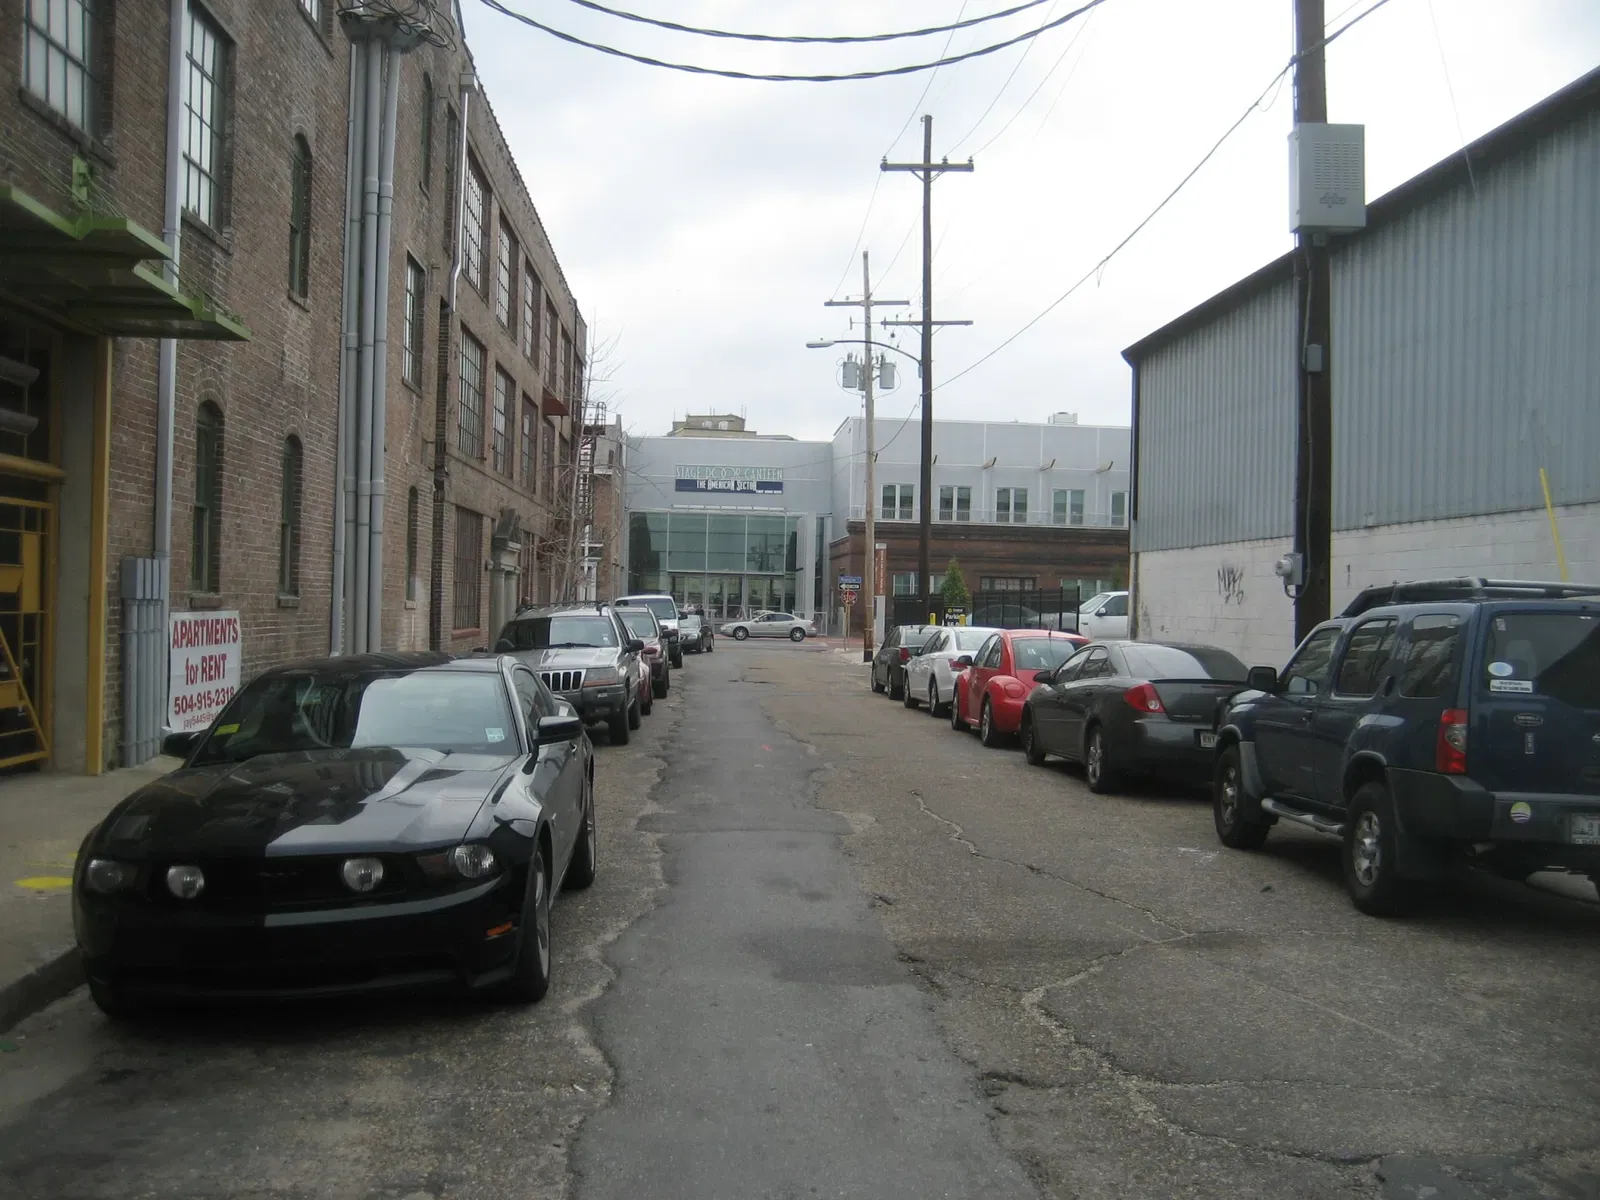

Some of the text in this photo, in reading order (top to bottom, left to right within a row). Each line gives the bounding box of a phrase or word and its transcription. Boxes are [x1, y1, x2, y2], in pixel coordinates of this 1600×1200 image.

[676, 465, 783, 480] STAGE DOOR CANTEEN
[696, 479, 757, 491] THE AMERICAN SECTOR
[172, 617, 239, 649] APARTMENTS
[185, 653, 227, 685] for RENT
[174, 685, 235, 716] 504-915-2318
